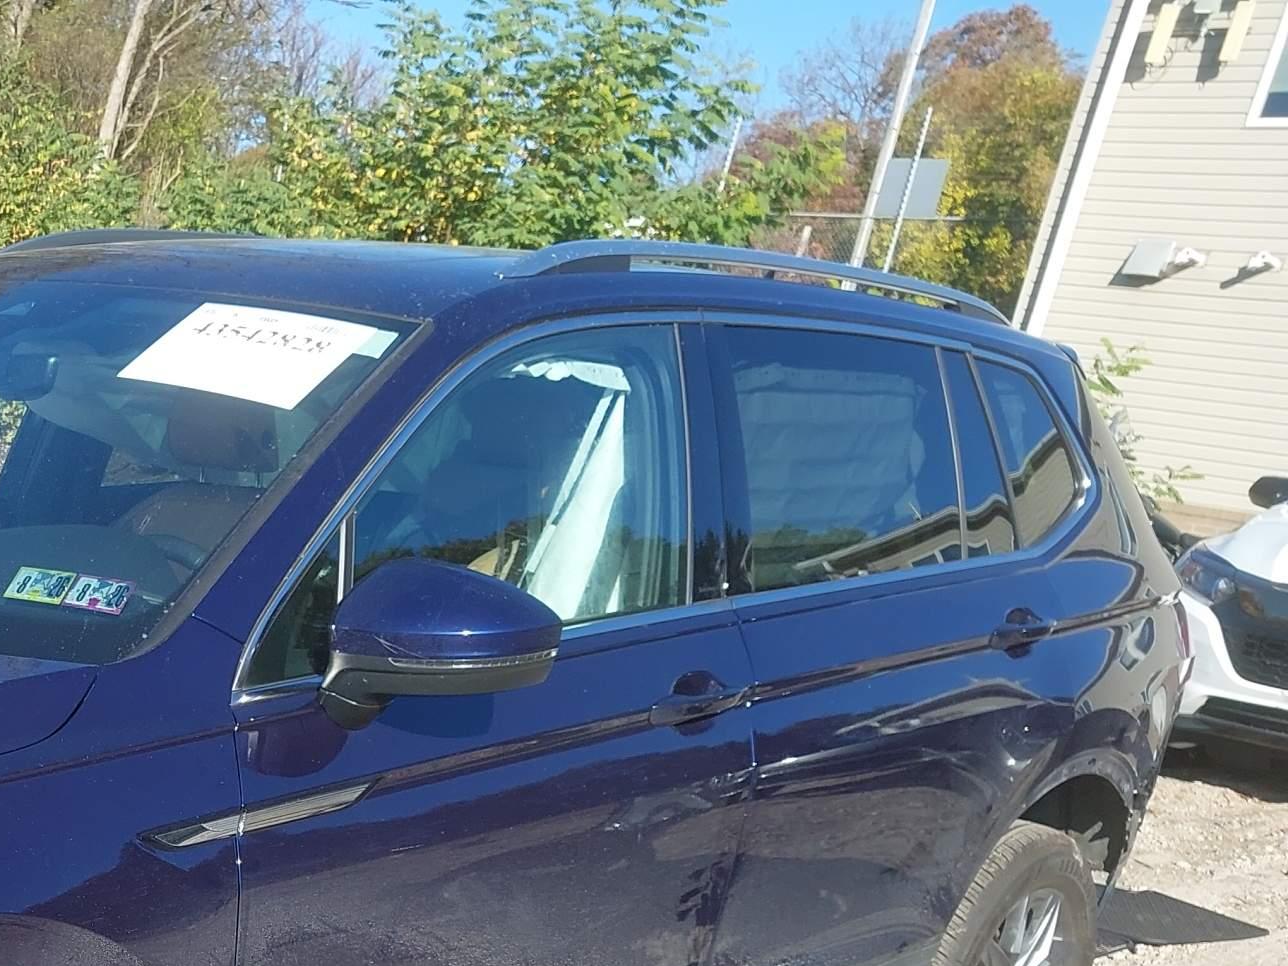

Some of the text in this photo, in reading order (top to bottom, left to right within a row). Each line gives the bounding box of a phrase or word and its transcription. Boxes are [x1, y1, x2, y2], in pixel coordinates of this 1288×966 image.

[192, 321, 332, 353] 43542828
[15, 575, 71, 599] 8 26
[76, 583, 130, 608] 8 26
